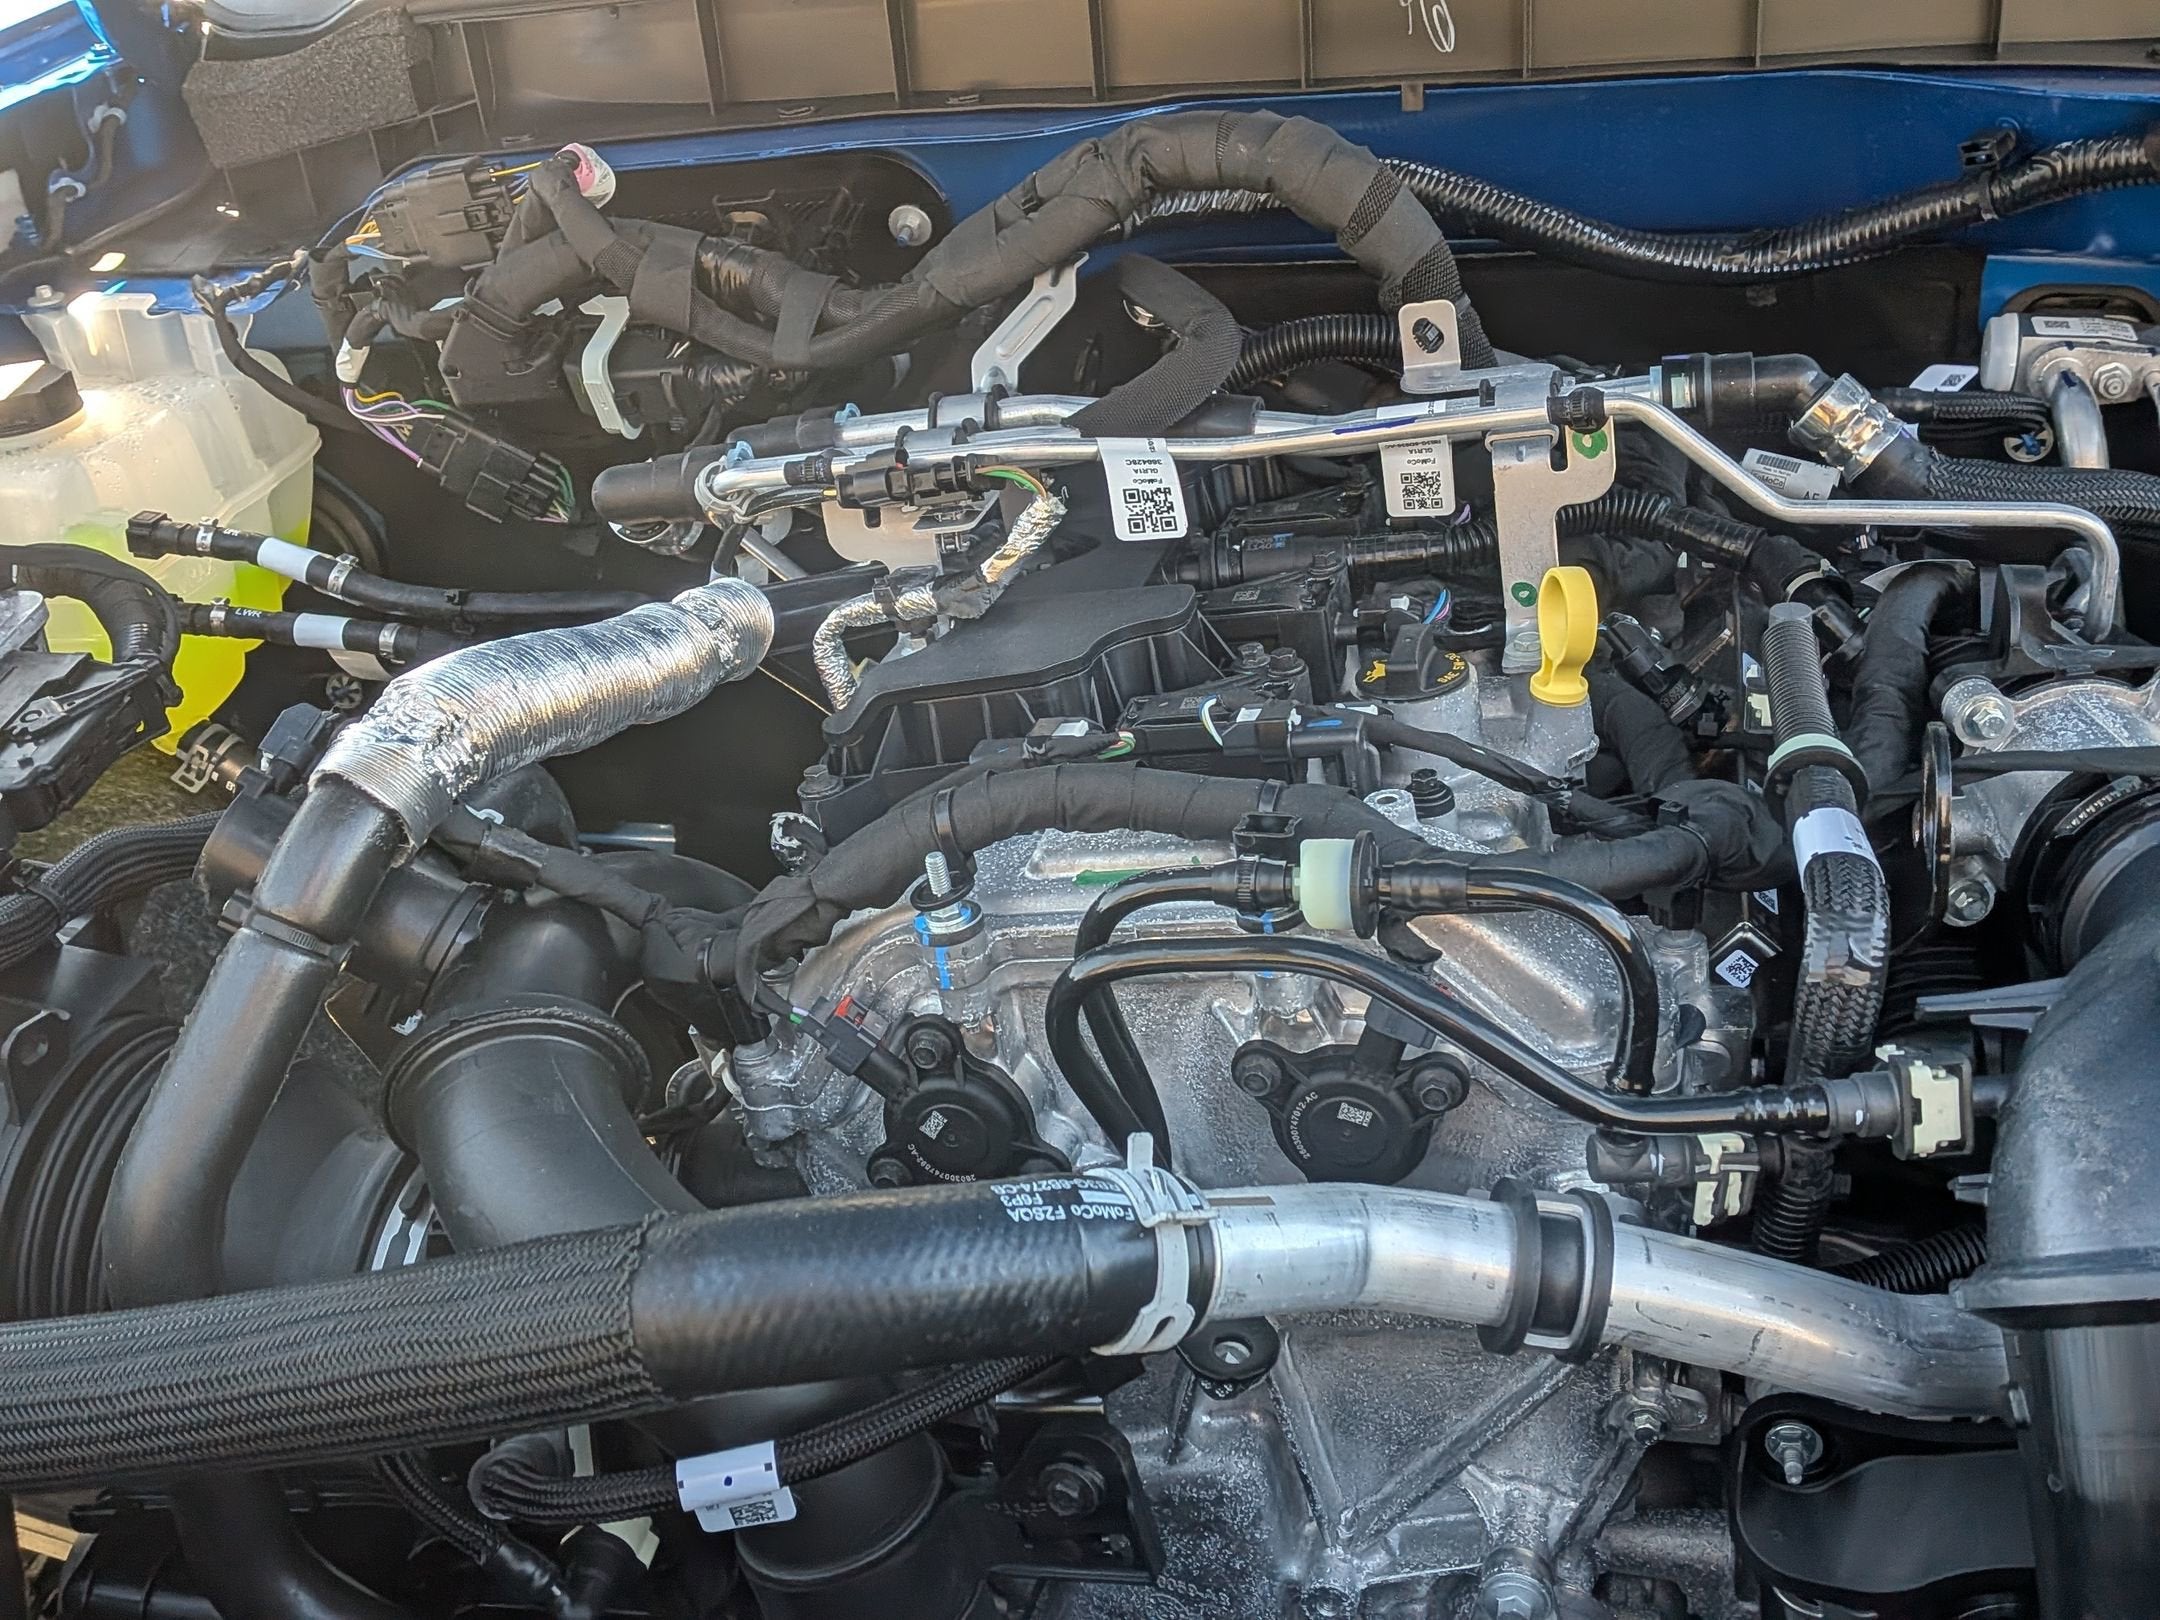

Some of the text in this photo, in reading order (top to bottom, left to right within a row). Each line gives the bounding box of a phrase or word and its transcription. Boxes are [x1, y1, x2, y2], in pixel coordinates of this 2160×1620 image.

[1406, 457, 1436, 466] FoMoCo
[1132, 477, 1163, 486] FoMoCo
[1070, 1203, 1135, 1222] FoMoCo
